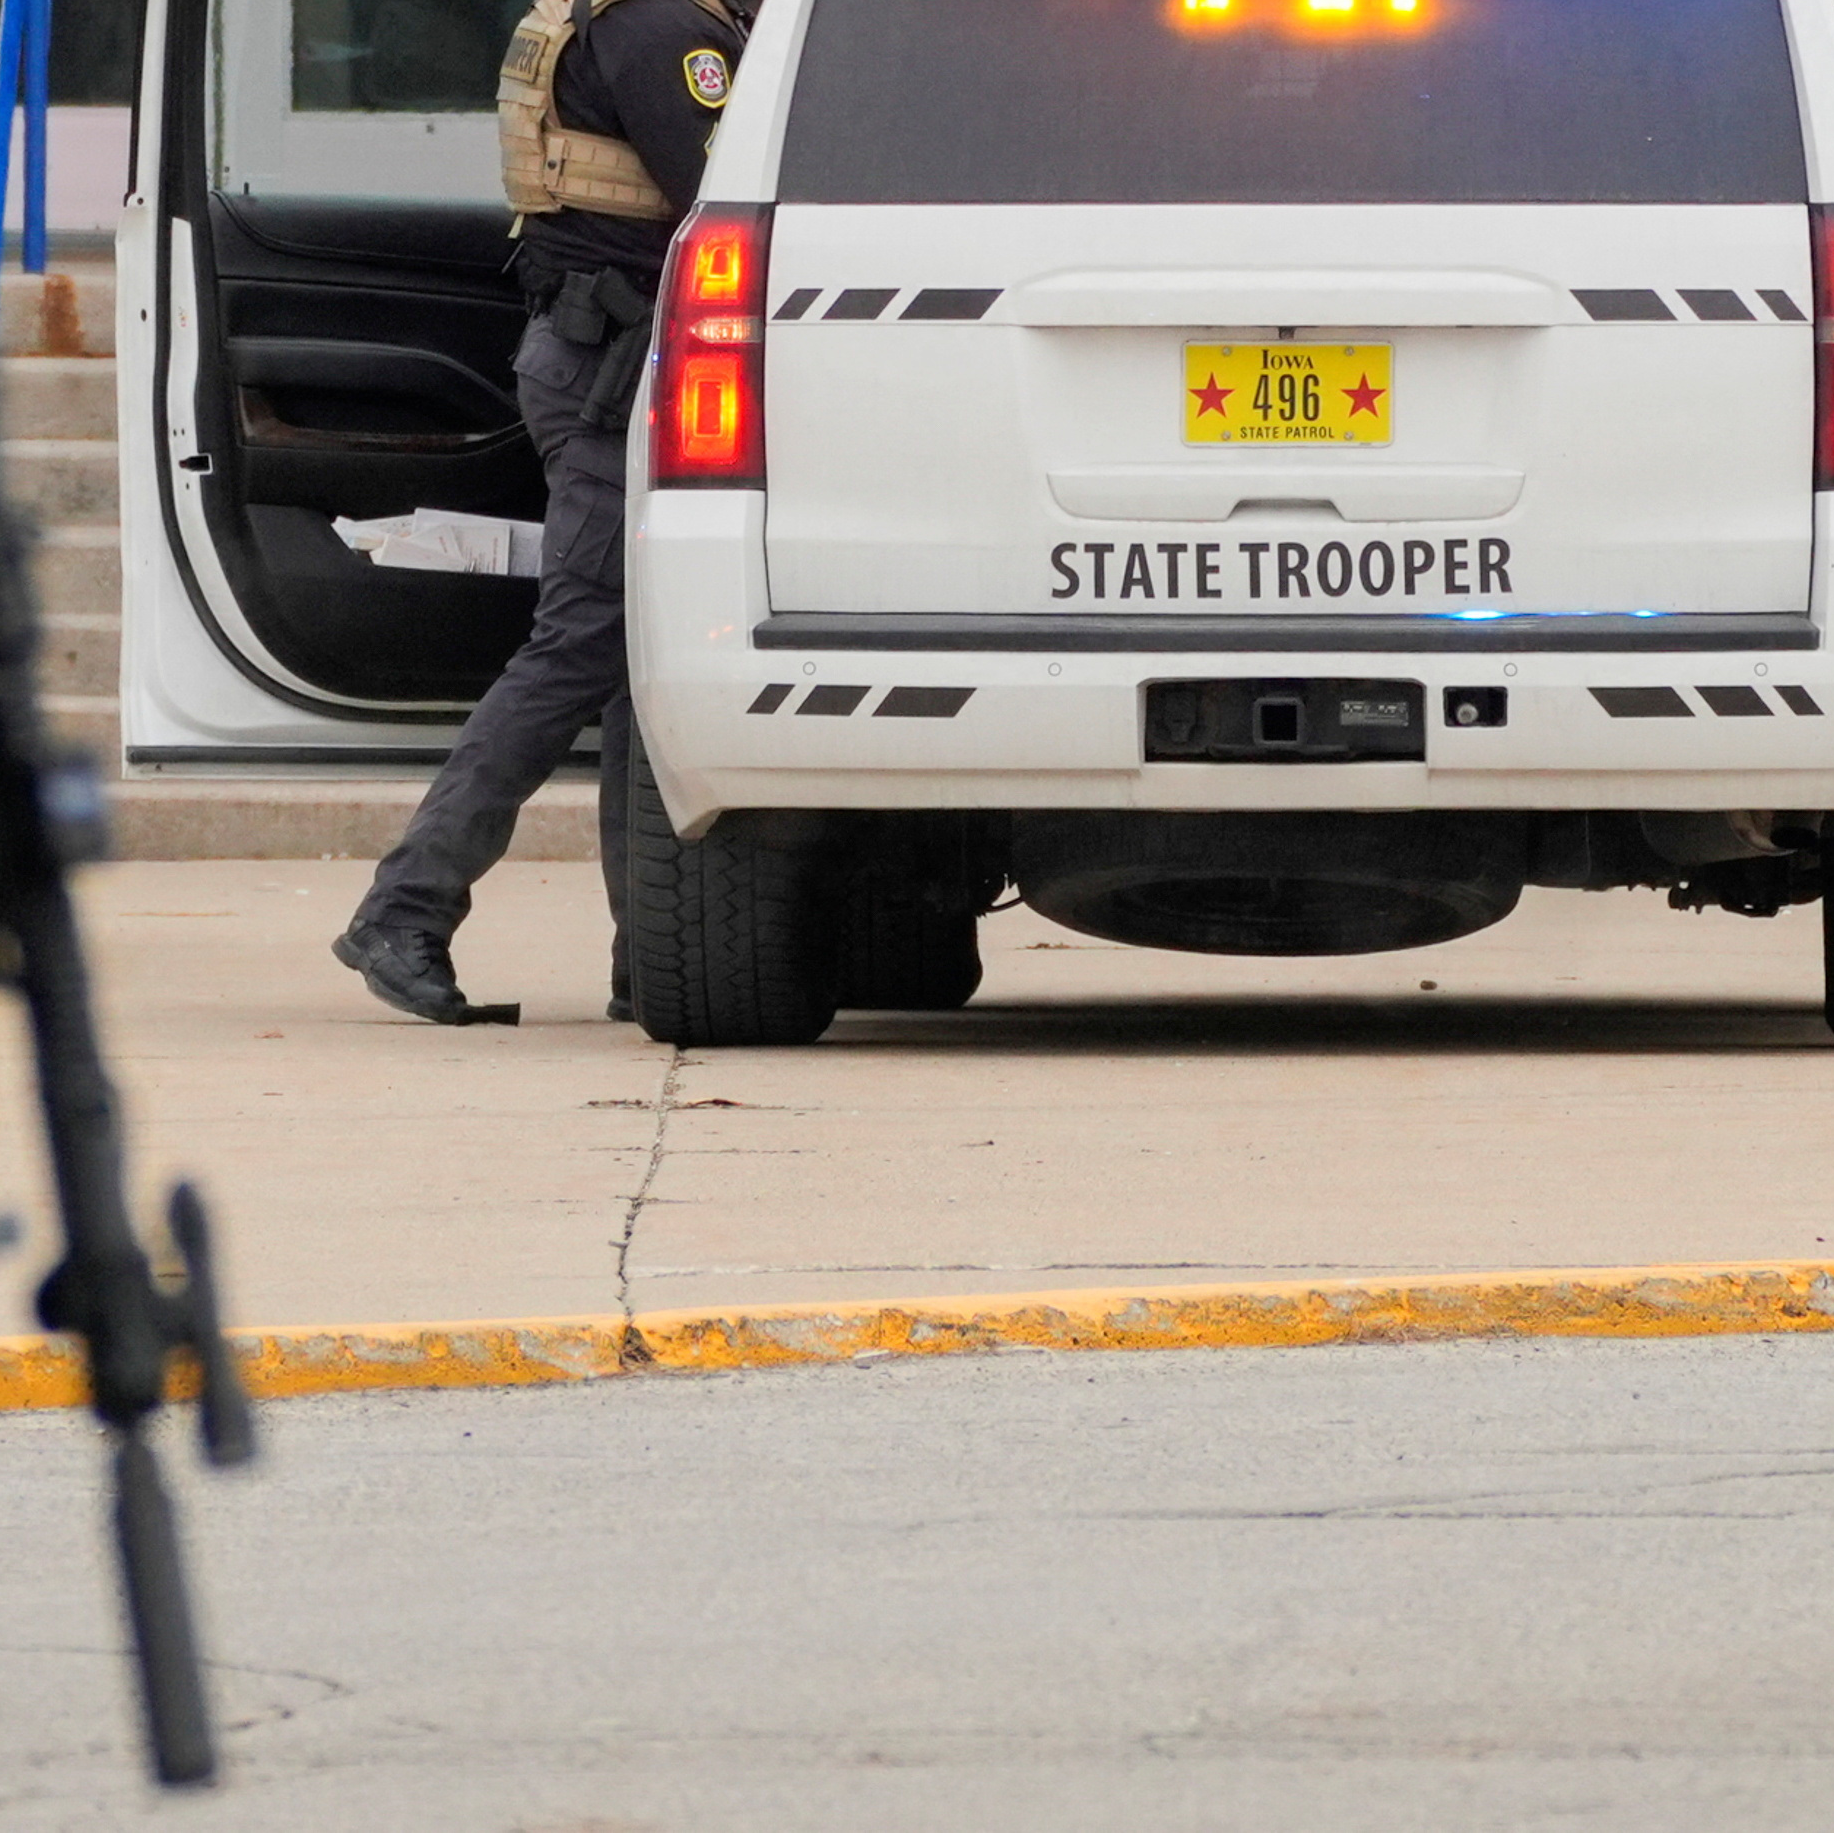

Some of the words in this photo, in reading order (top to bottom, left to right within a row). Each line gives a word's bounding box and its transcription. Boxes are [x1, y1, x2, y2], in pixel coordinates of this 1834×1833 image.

[1252, 373, 1320, 422] 496
[1239, 426, 1280, 439] STATE
[1285, 425, 1335, 439] PATROL
[1050, 542, 1223, 599] STATE
[1238, 537, 1514, 599] TROOPER
